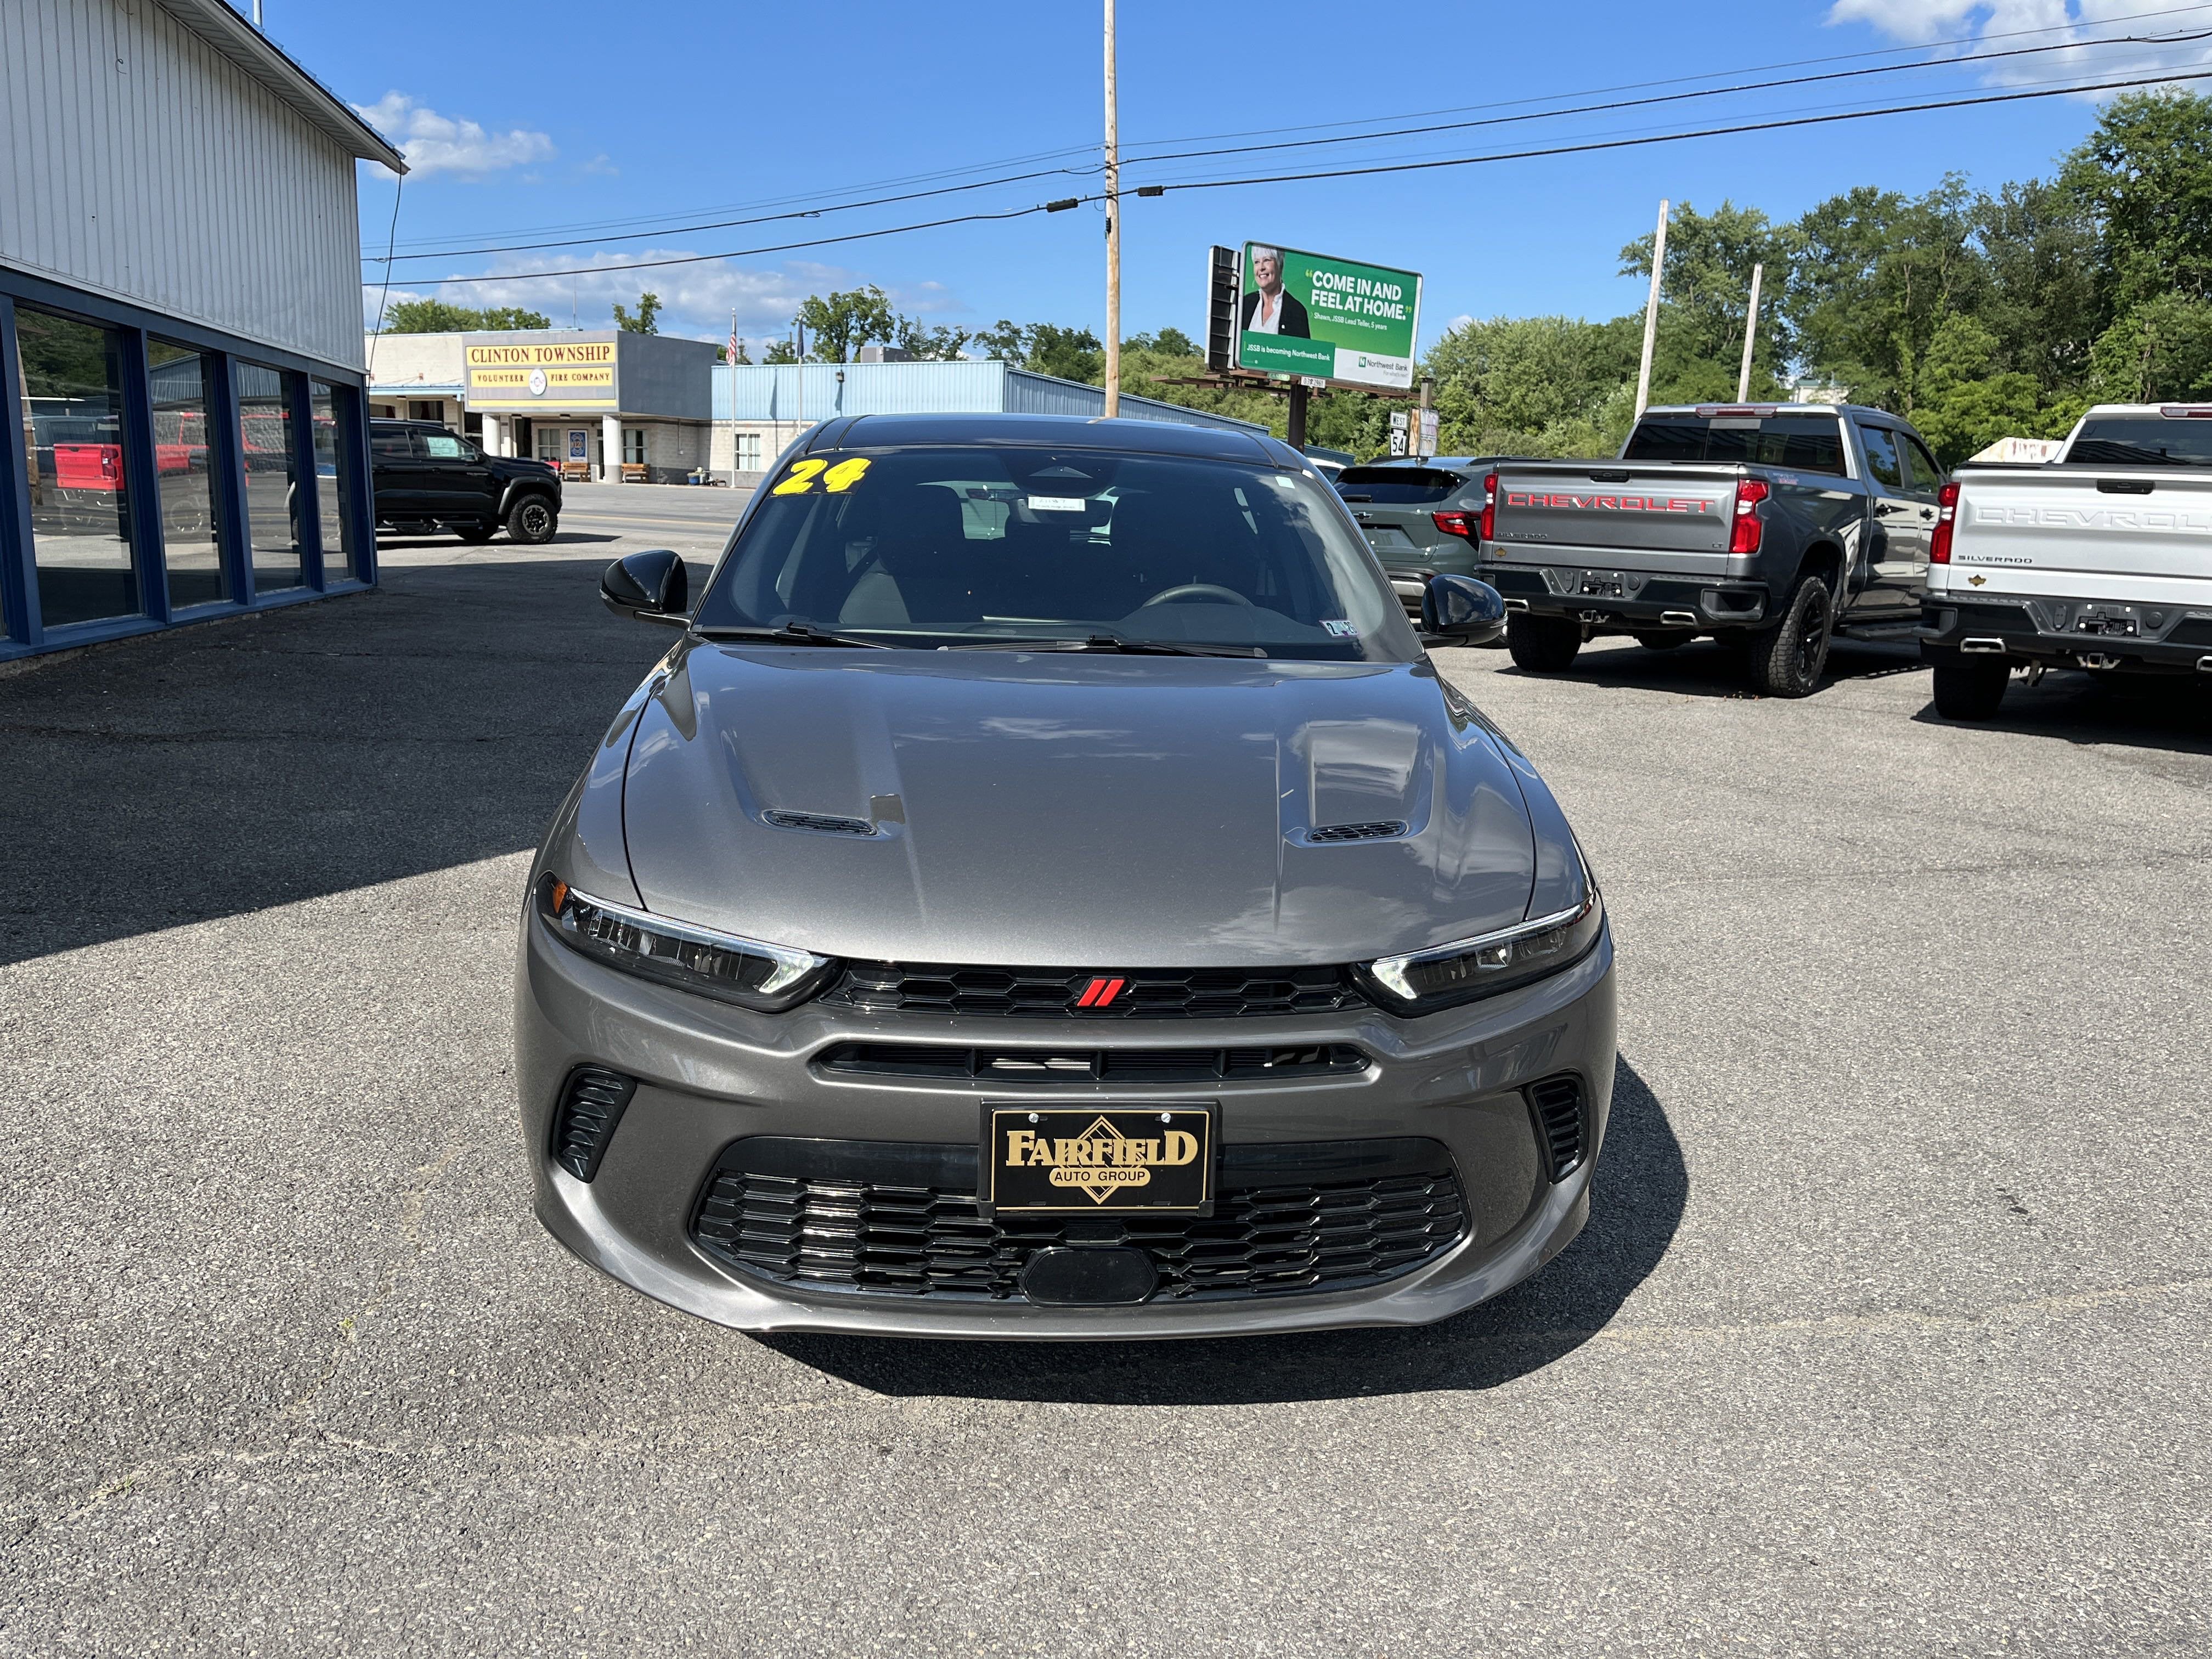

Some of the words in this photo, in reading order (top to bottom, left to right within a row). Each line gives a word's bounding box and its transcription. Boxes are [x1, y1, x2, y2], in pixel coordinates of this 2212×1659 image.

[1357, 278, 1372, 296] IN
[1372, 282, 1402, 301] AND
[1311, 289, 1343, 310] FEEL
[1344, 295, 1363, 312] AT
[471, 347, 529, 363] CLINTON
[535, 346, 610, 362] TOWNSHIP
[1266, 346, 1291, 357] becoming
[1292, 349, 1317, 359] Northwest
[1318, 353, 1330, 361] Bank
[1367, 359, 1394, 370] Northwest
[1395, 363, 1408, 371] Bank
[572, 373, 610, 381] COMPANY
[1393, 415, 1405, 426] WEST
[1392, 436, 1403, 453] 54
[772, 458, 872, 495] 24
[1508, 493, 1715, 514] CHEVROLET
[1975, 507, 2212, 532] CHEVROL
[1497, 531, 1547, 539] SILVERADO
[1958, 555, 2032, 564] SILVERADO
[1006, 1130, 1198, 1166] FAIRFIELD
[1054, 1171, 1090, 1182] AUTO
[1098, 1171, 1146, 1181] GROUP
